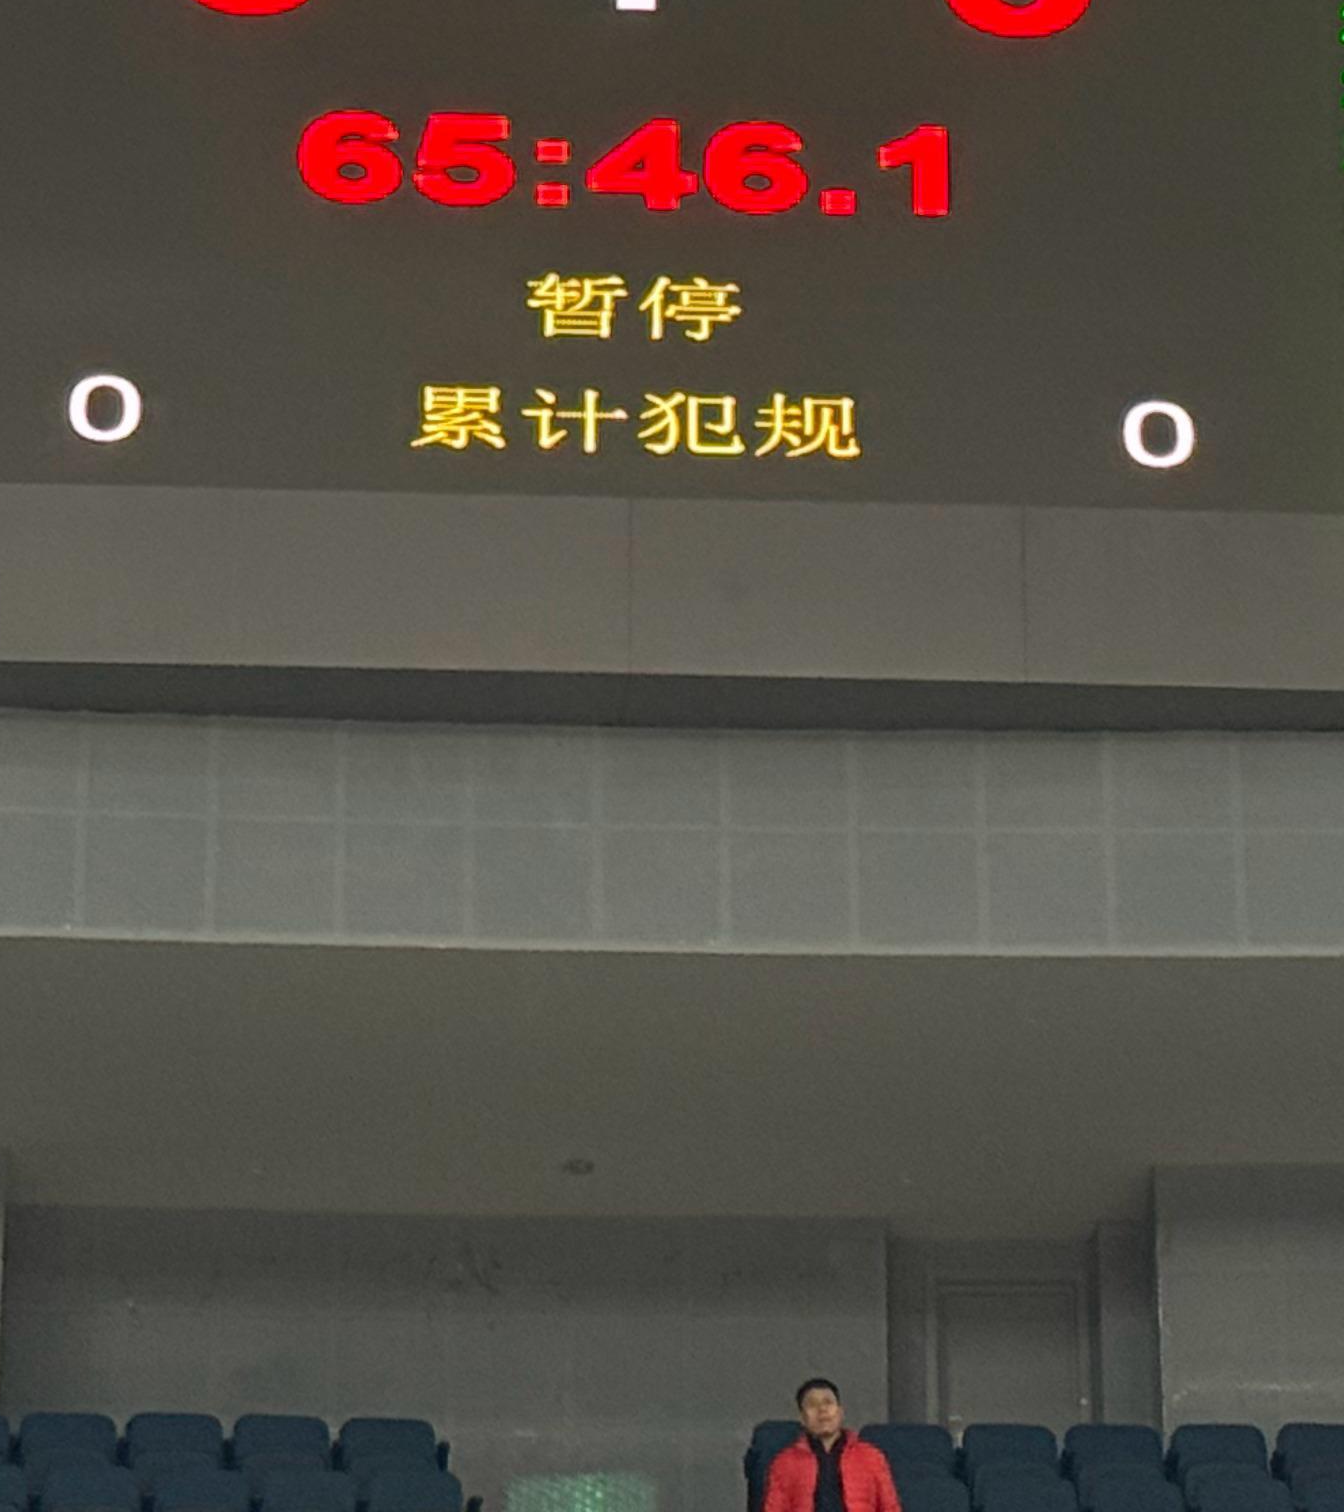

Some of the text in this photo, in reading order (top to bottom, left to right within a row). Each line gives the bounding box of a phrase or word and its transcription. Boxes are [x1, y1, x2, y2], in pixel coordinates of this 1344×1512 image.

[296, 109, 949, 218] 65:46.1
[528, 276, 739, 340] 暂停
[70, 375, 140, 441] 0
[417, 384, 860, 460] 累计犯规
[1124, 402, 1194, 467] 0
